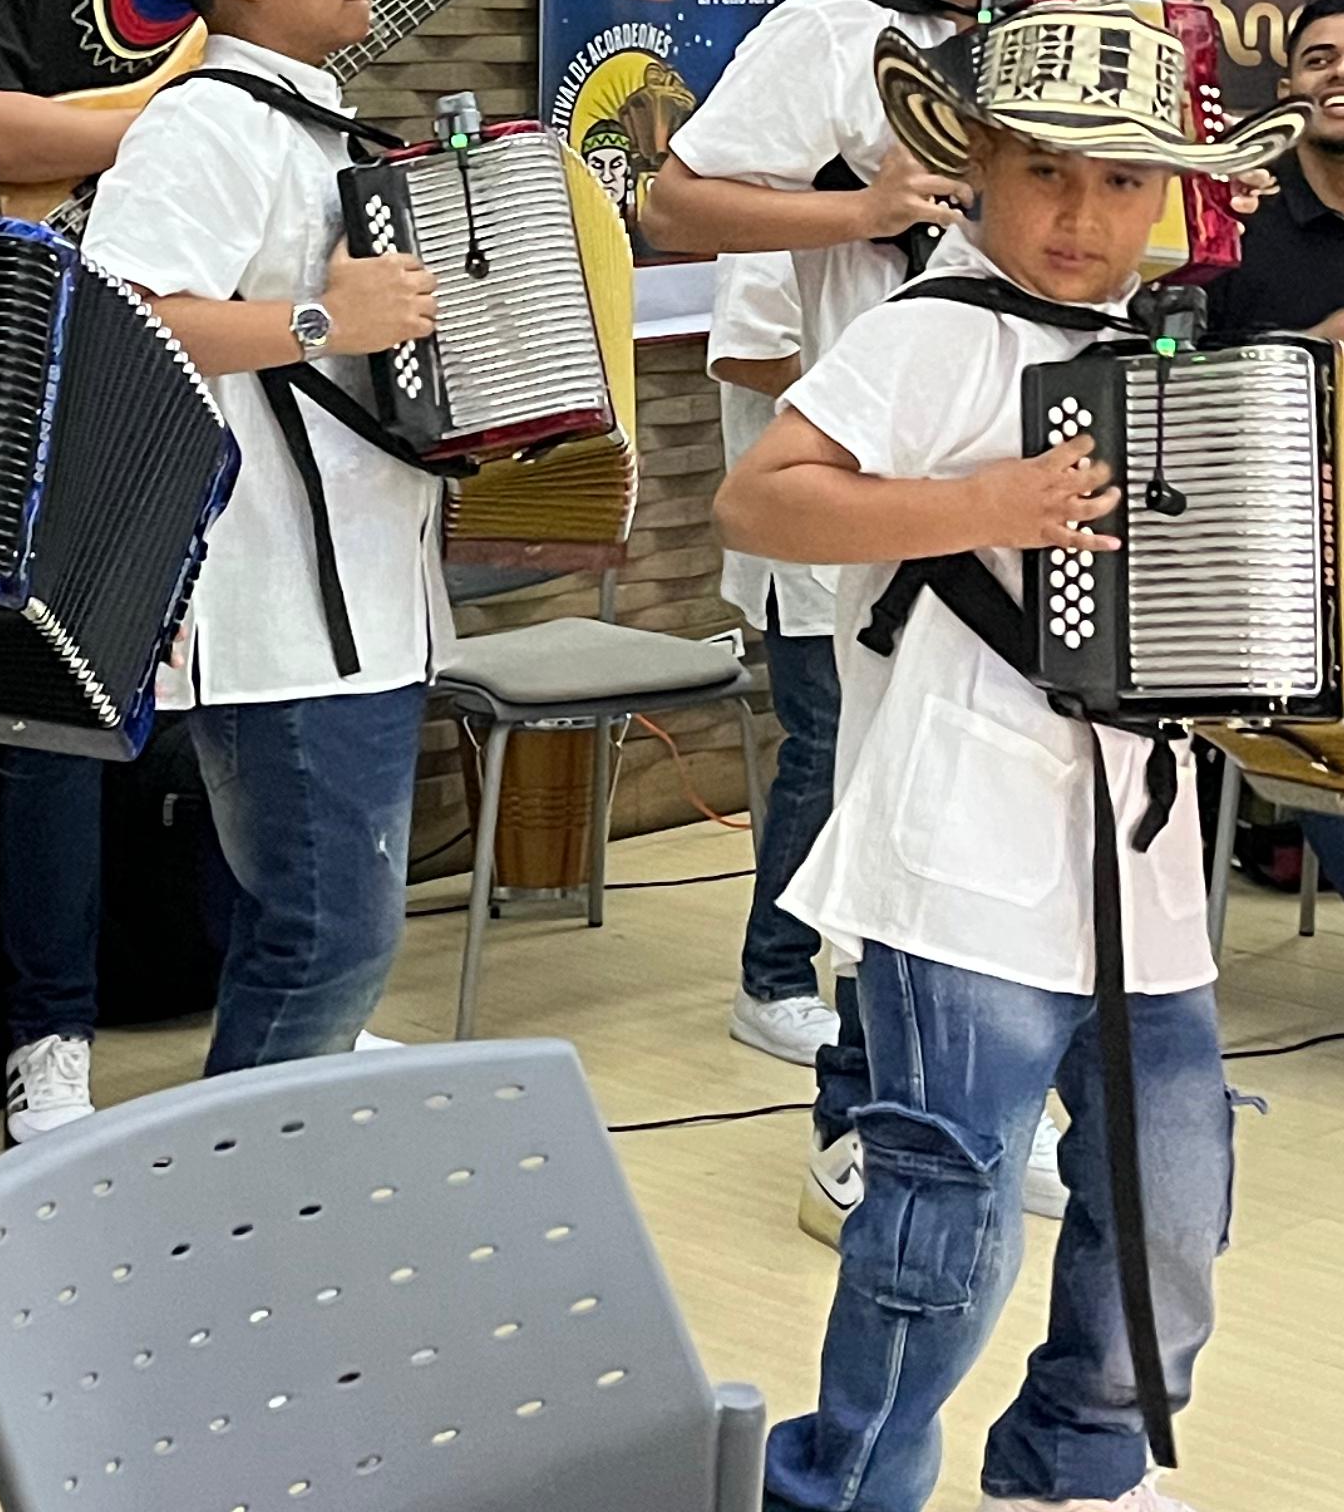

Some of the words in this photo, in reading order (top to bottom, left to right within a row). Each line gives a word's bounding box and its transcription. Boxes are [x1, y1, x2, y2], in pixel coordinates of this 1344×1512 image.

[567, 50, 593, 83] DE
[586, 22, 674, 66] ACORDEONES
[32, 363, 61, 483] HOHNER
